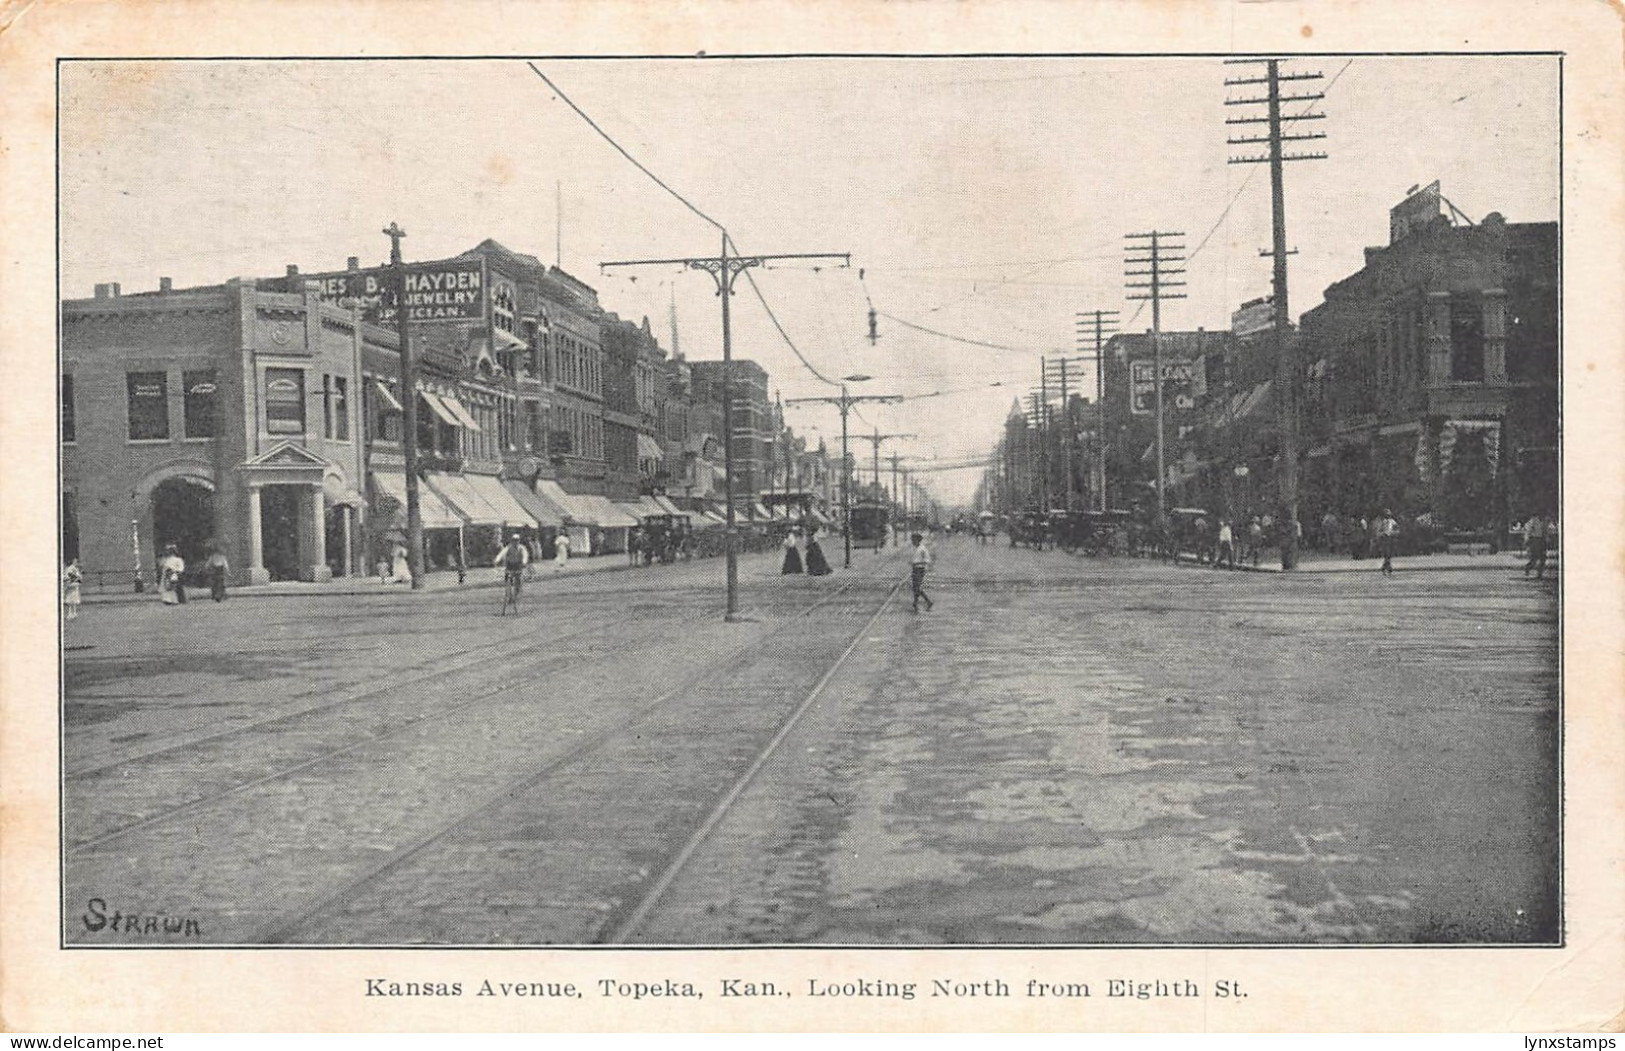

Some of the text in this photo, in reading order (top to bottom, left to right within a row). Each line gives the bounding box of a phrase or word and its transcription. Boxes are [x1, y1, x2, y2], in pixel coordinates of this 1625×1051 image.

[365, 276, 387, 293] B.
[404, 271, 481, 292] HAYDEN
[404, 290, 479, 307] JEWELRY
